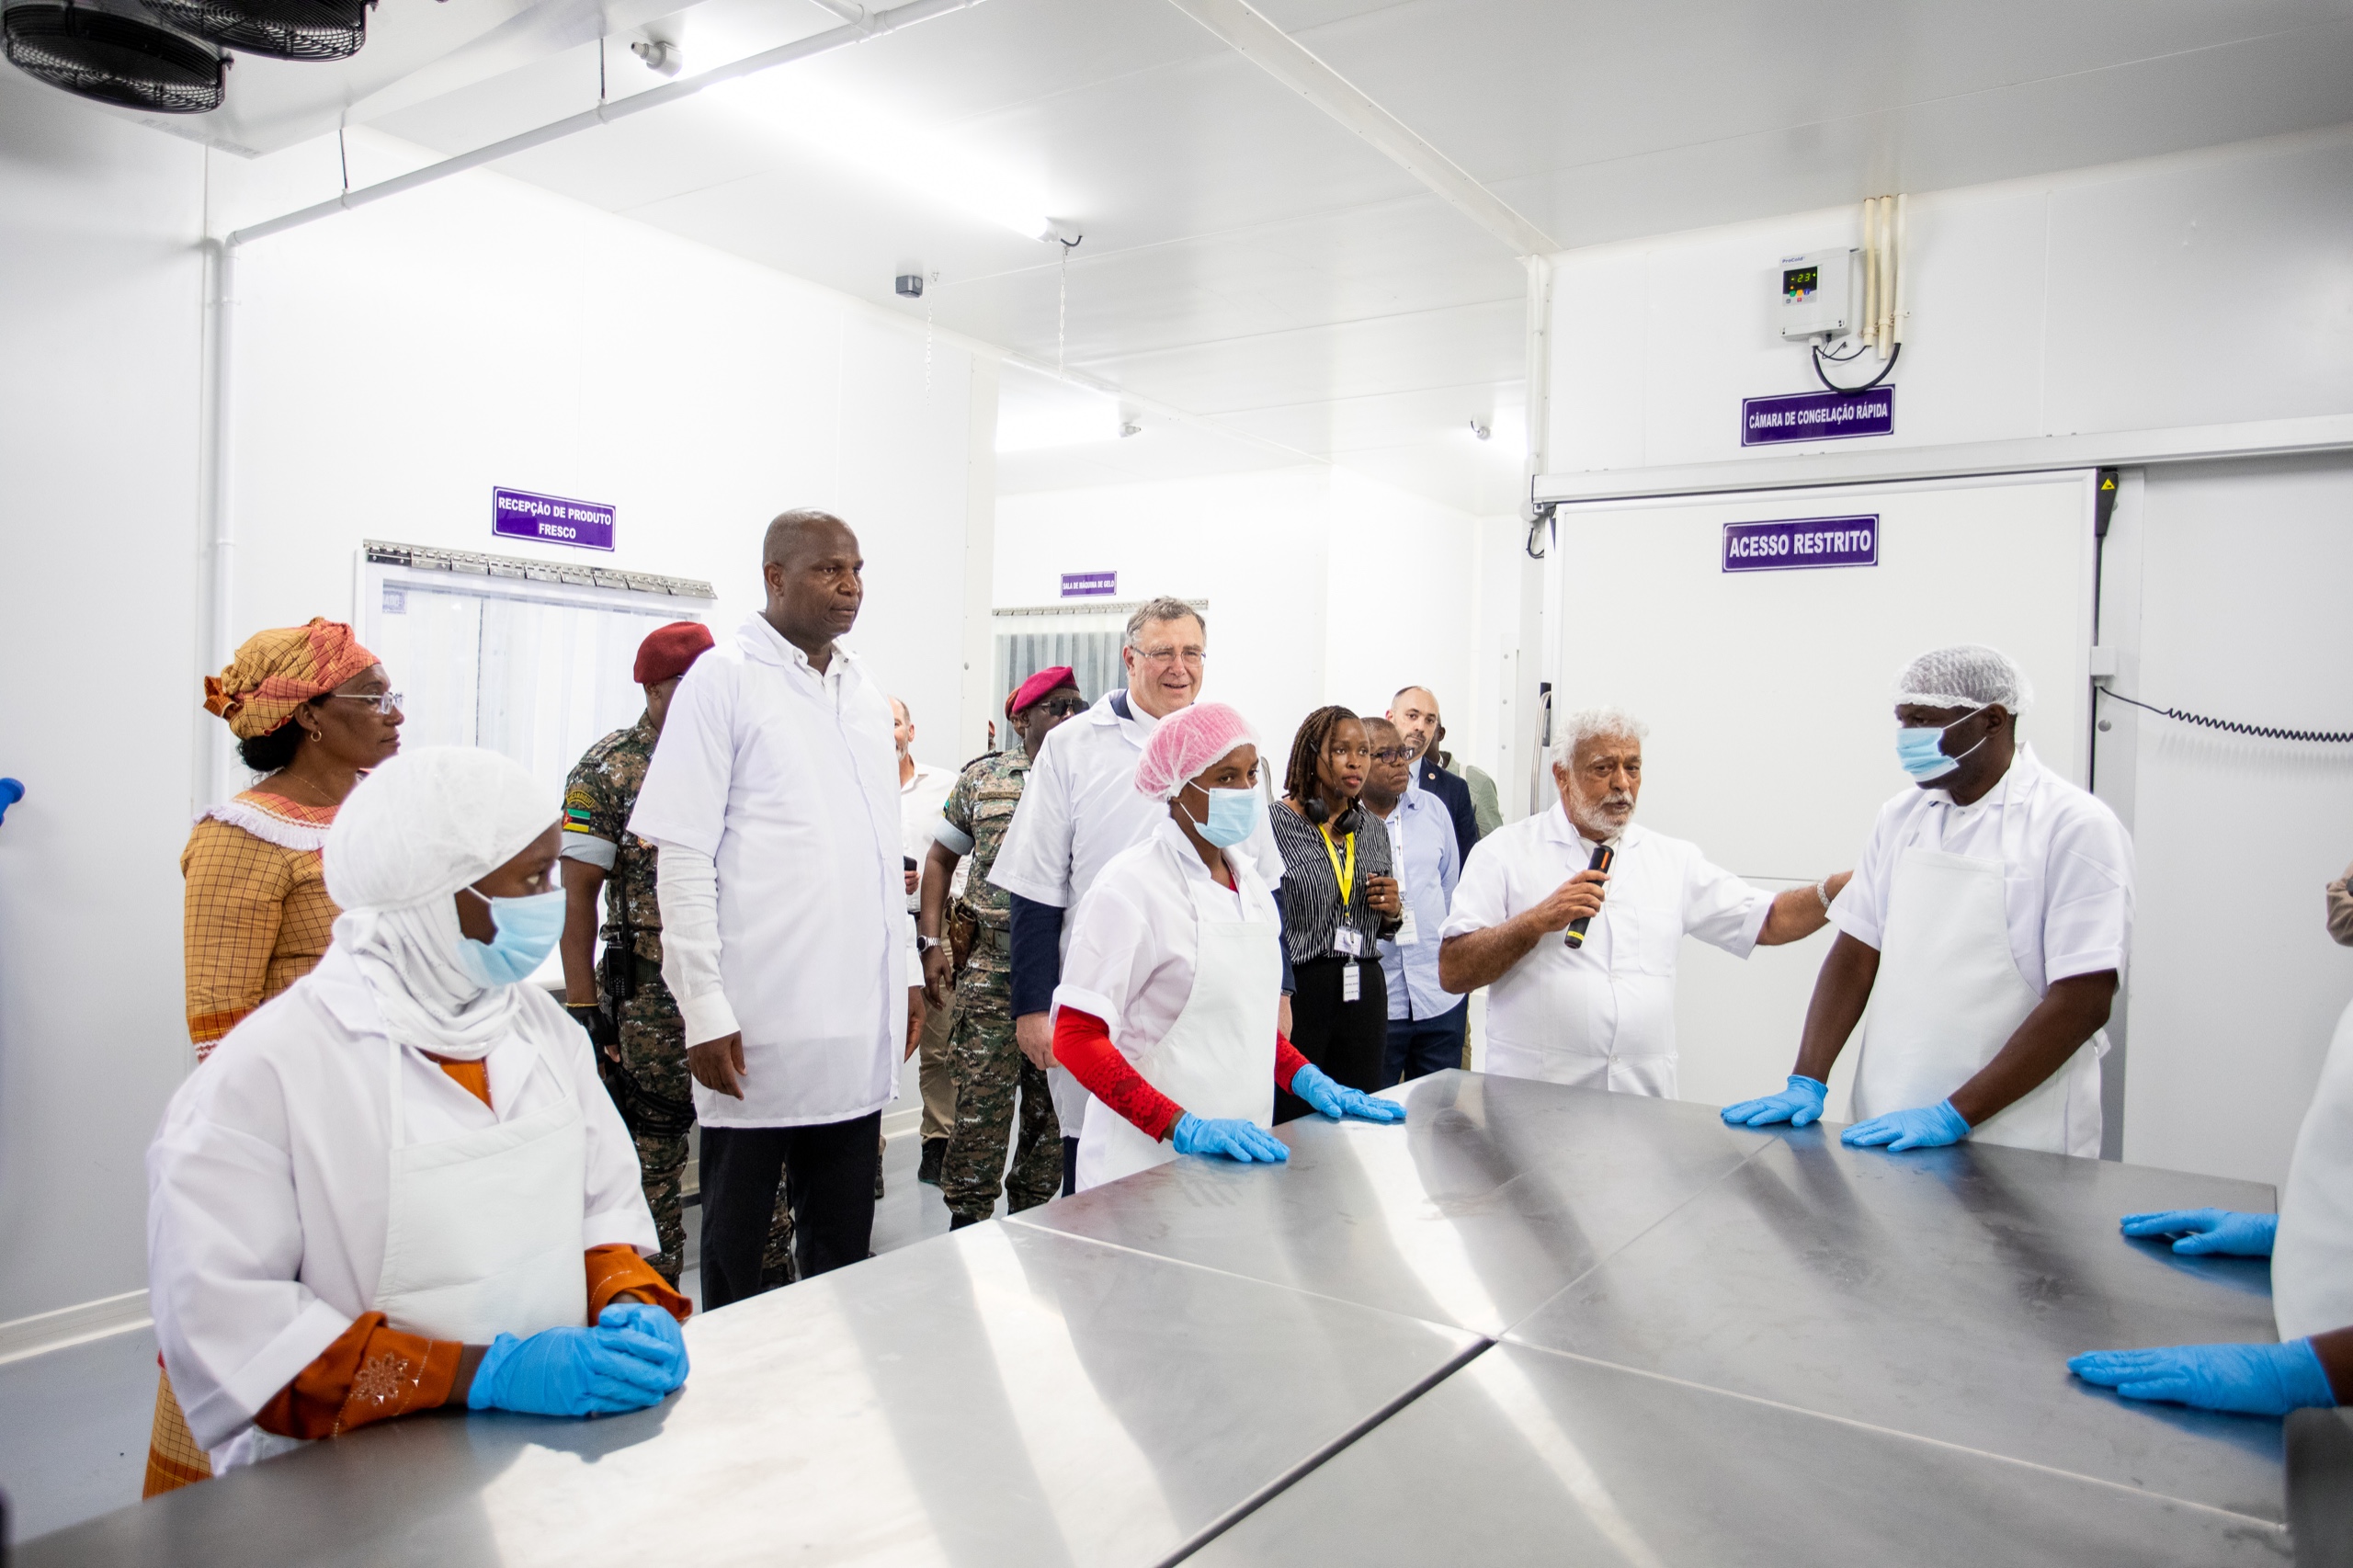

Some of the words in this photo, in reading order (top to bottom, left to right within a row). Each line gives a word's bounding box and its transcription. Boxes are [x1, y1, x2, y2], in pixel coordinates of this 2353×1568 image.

[1748, 411, 1783, 429] CÂMARA
[1784, 411, 1796, 426] DE
[1797, 403, 1855, 426] CONGELAÇÃO
[1856, 401, 1888, 419] RÁPIDA
[498, 496, 551, 517] RECEPÇÃO
[552, 506, 566, 518] DE
[568, 507, 612, 526] PRODUTO
[539, 522, 576, 540] FRESCO
[1728, 534, 1789, 558] ACESSO
[1793, 529, 1871, 555] RESTRITO
[1063, 582, 1073, 590] SALA
[1104, 579, 1114, 588] GELO
